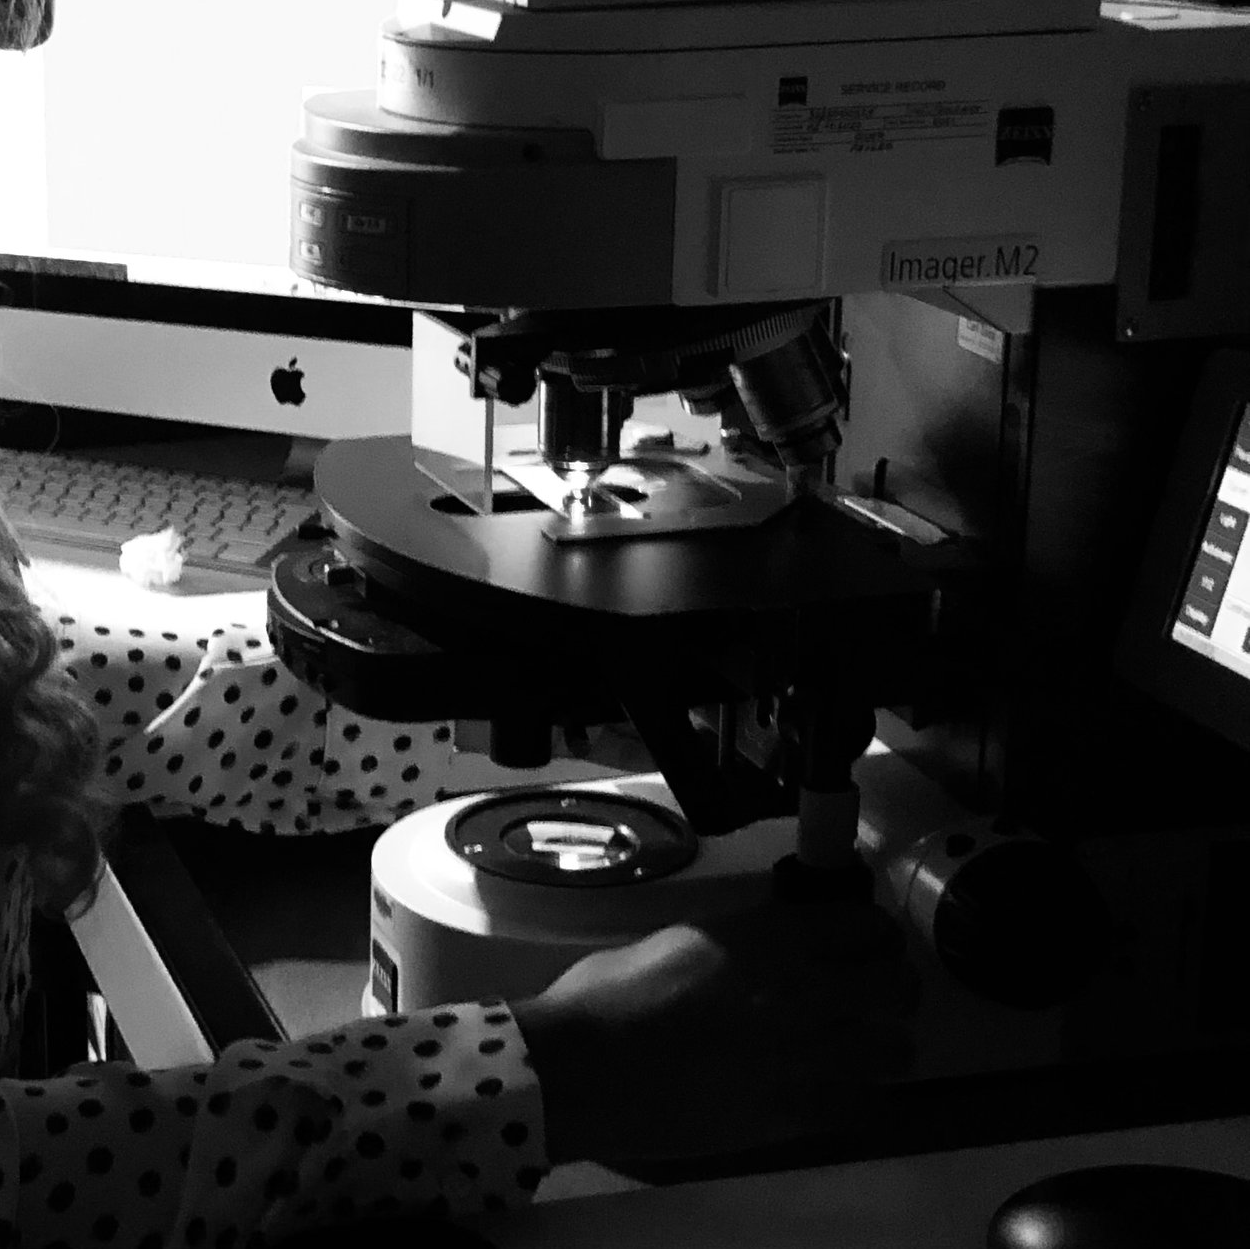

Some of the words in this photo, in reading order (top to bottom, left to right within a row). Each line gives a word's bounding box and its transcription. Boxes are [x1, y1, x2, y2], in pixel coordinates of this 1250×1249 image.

[840, 81, 891, 95] SERVICE
[894, 79, 946, 93] RECORD
[888, 244, 1040, 284] Imager.M2
